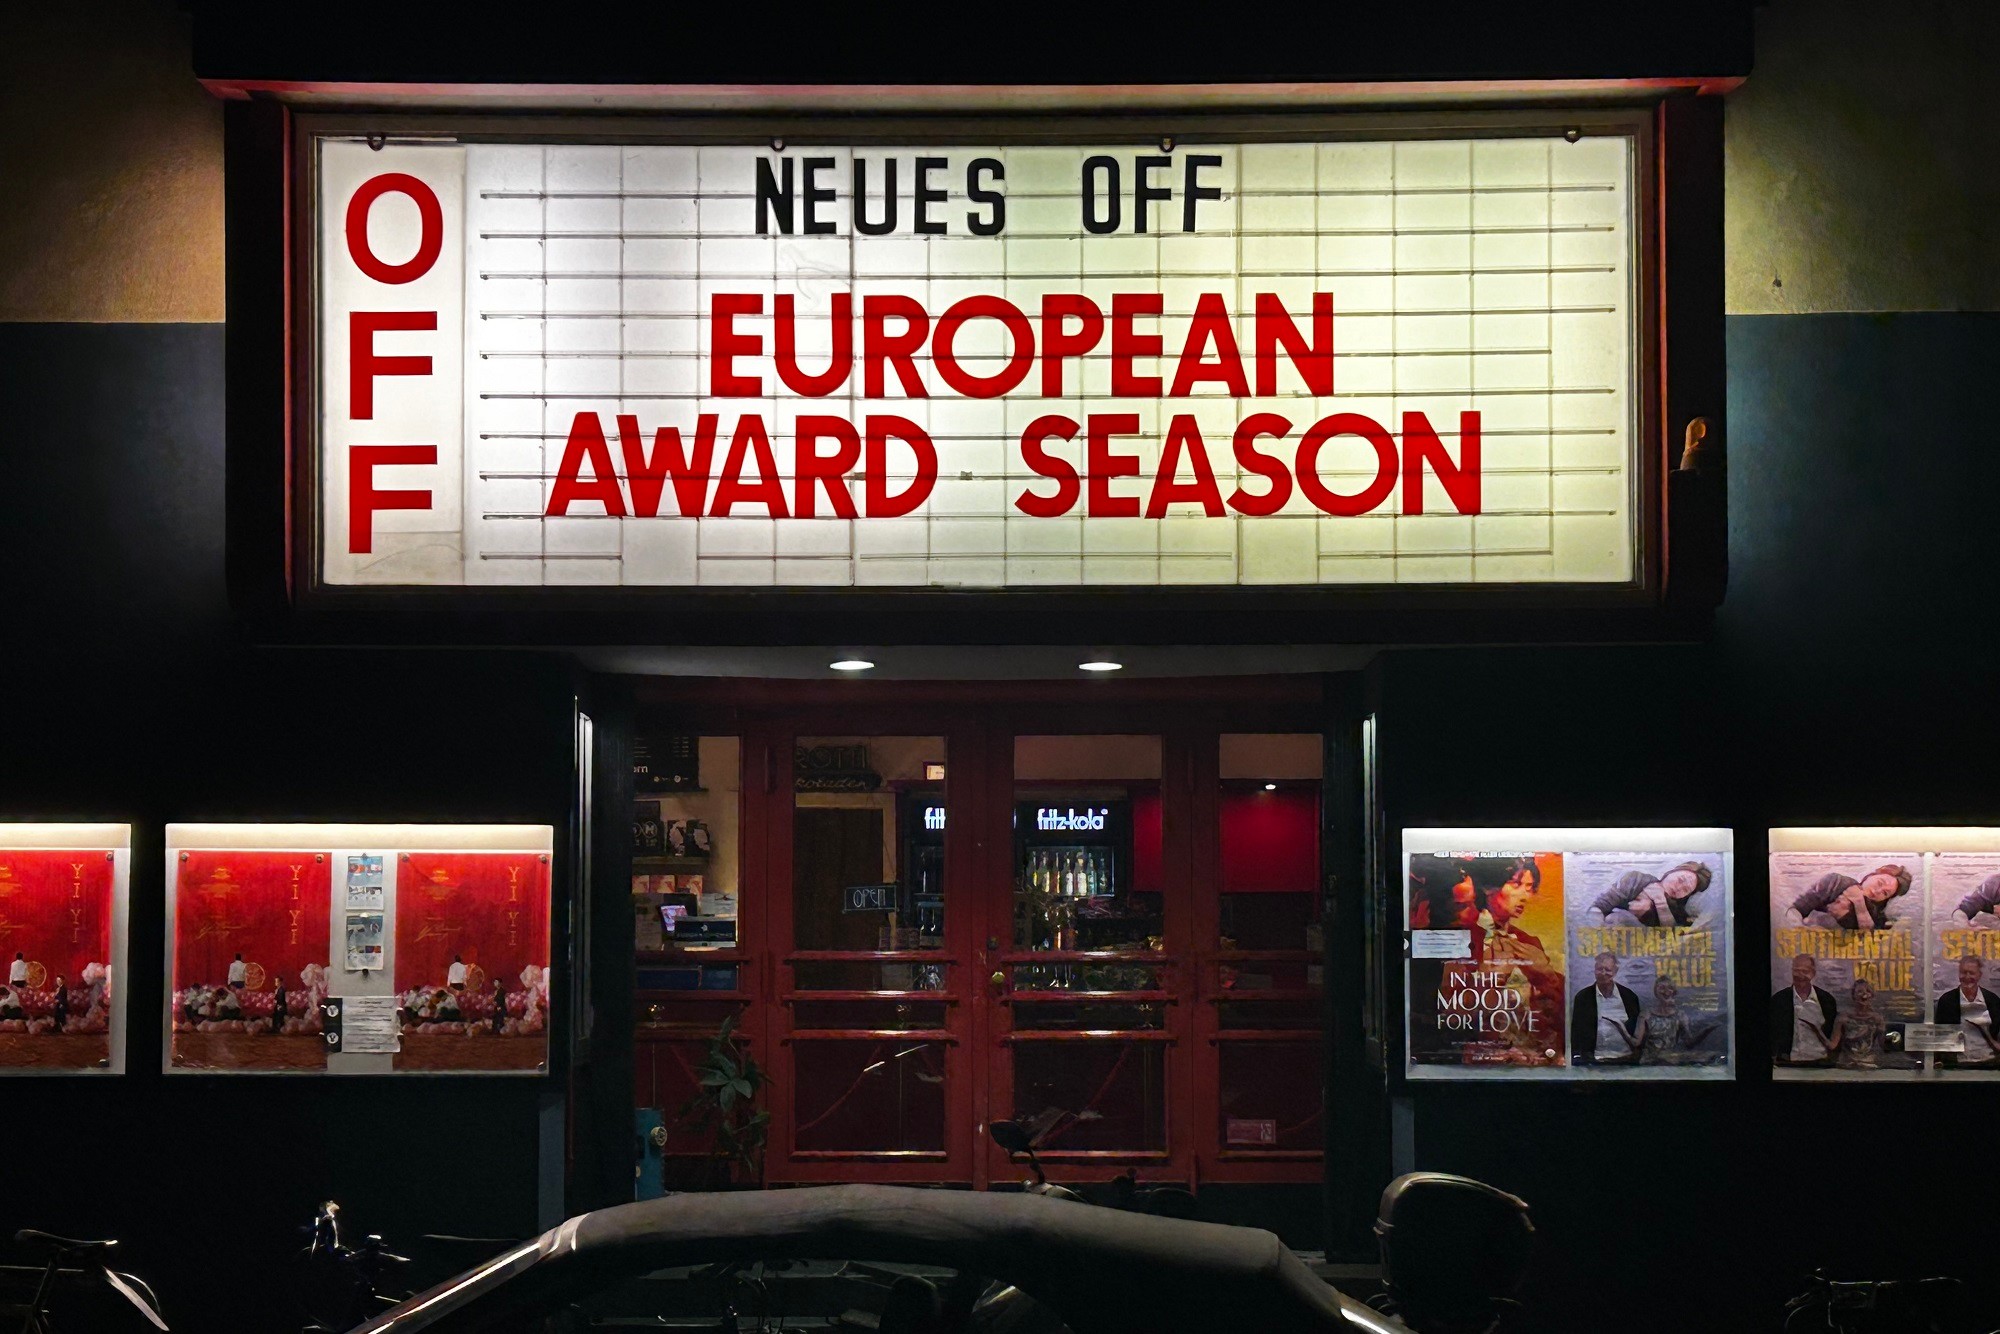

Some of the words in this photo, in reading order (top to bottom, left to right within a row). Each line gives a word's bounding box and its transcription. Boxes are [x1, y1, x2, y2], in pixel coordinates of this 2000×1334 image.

[756, 155, 1005, 235] NEUES
[1081, 155, 1223, 234] OFF
[711, 292, 1334, 398] EUROPEAN
[345, 172, 443, 554] OFF
[545, 411, 936, 519] AWARD
[1014, 411, 1482, 518] SEASON
[1037, 807, 1105, 830] fritz-kola
[1775, 929, 1915, 960] SENTIMENTAL
[1450, 971, 1467, 988] IN
[1471, 971, 1506, 988] THE
[1437, 988, 1521, 1011] MOOD
[1437, 1013, 1473, 1031] FOR
[1479, 1009, 1541, 1033] LOVE
